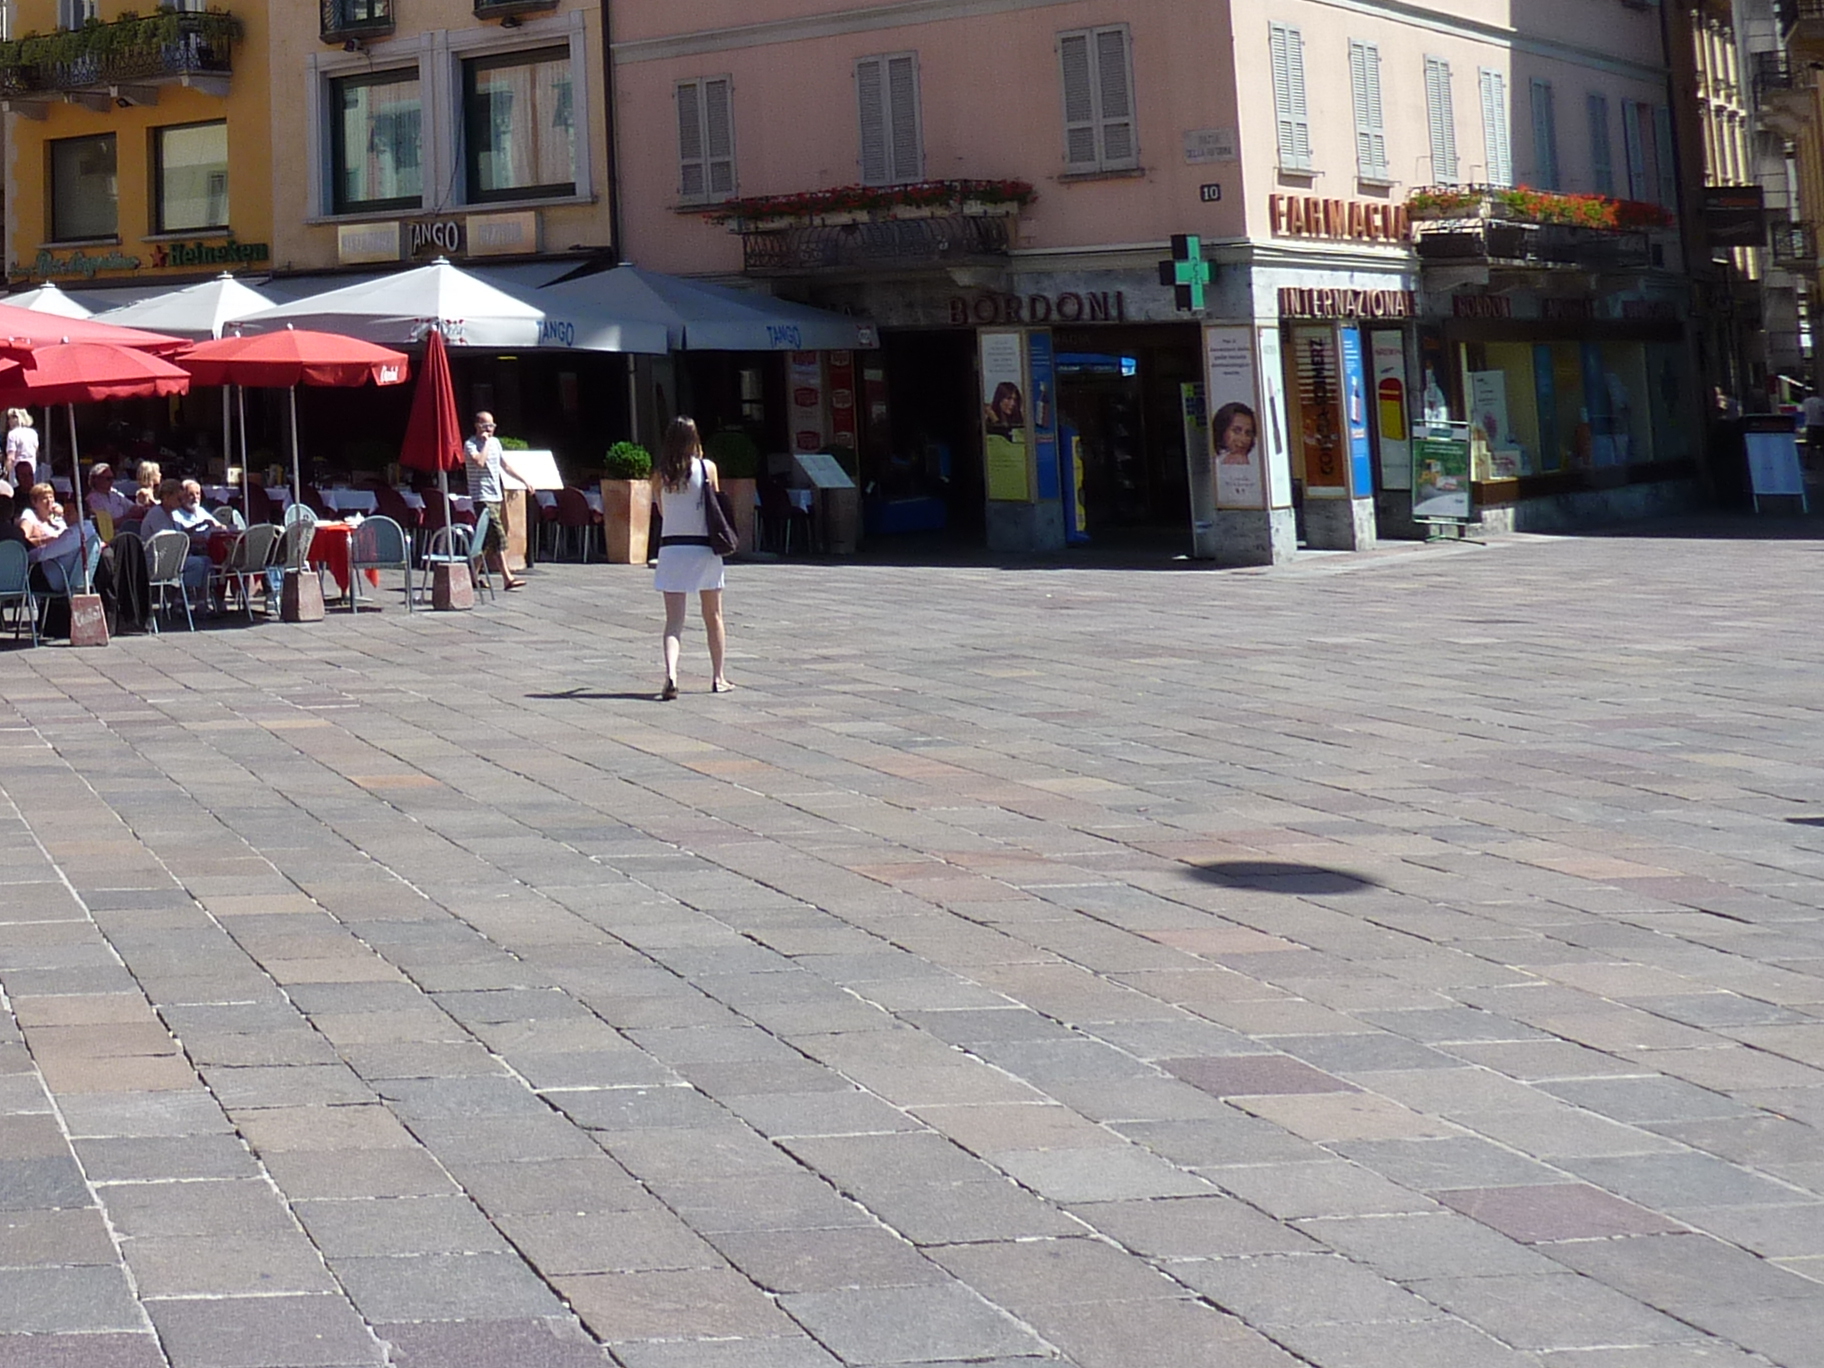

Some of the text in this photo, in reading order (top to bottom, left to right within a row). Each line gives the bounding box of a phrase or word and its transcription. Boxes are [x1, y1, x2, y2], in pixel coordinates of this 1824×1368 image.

[1203, 186, 1219, 200] 10
[1269, 194, 1413, 241] FARMACIA
[409, 221, 459, 256] TANGO
[168, 240, 269, 266] Heineken
[949, 291, 1124, 324] BORDONI
[537, 320, 575, 347] TANGO
[766, 325, 801, 350] TANGO
